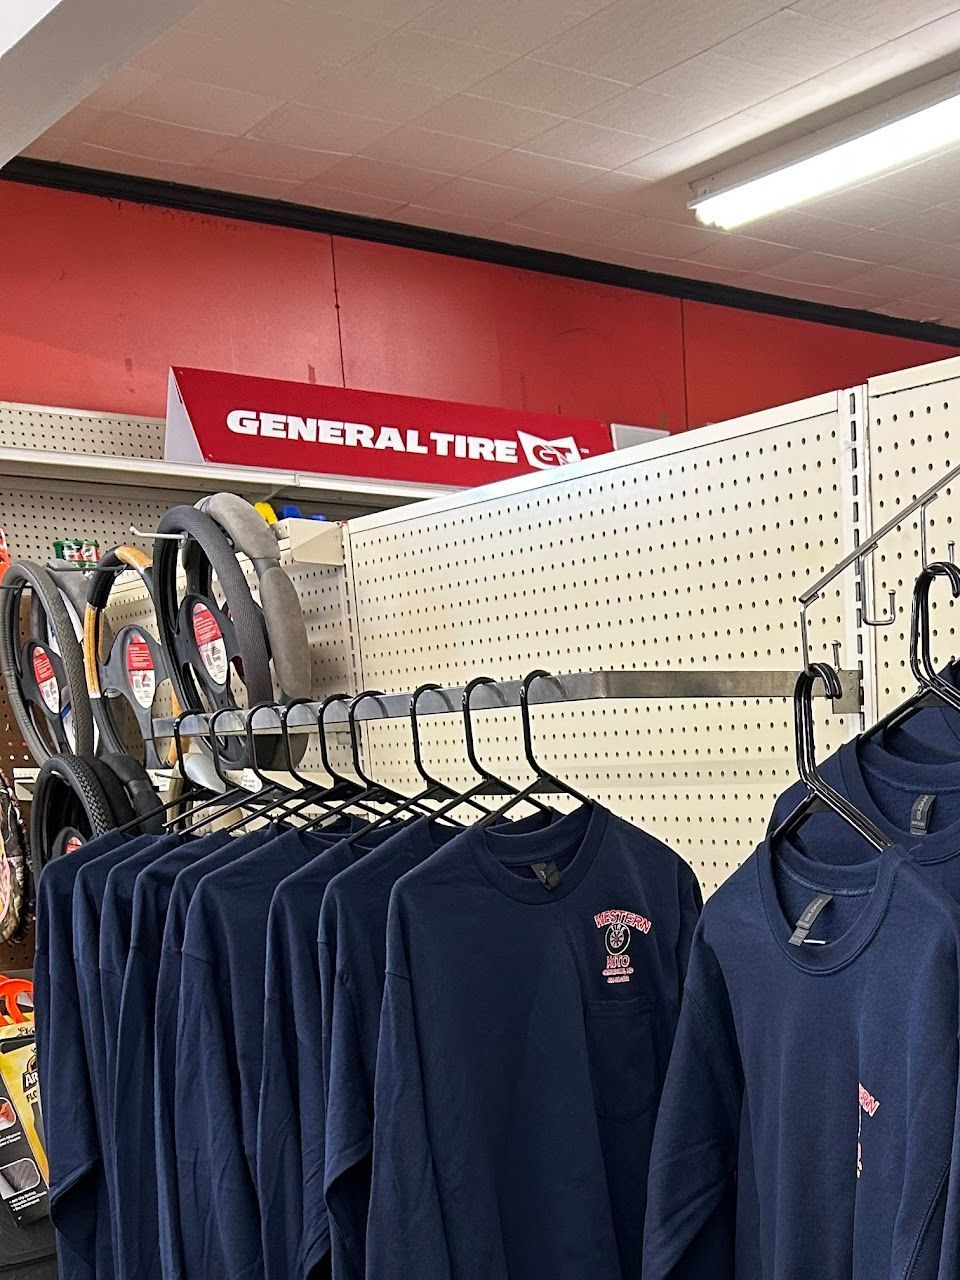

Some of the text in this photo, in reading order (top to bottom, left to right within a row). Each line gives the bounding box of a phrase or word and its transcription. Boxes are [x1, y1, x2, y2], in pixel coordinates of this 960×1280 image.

[226, 409, 518, 464] GENERAL TIRE
[594, 909, 652, 934] WESTERN
[606, 954, 630, 969] AUTO
